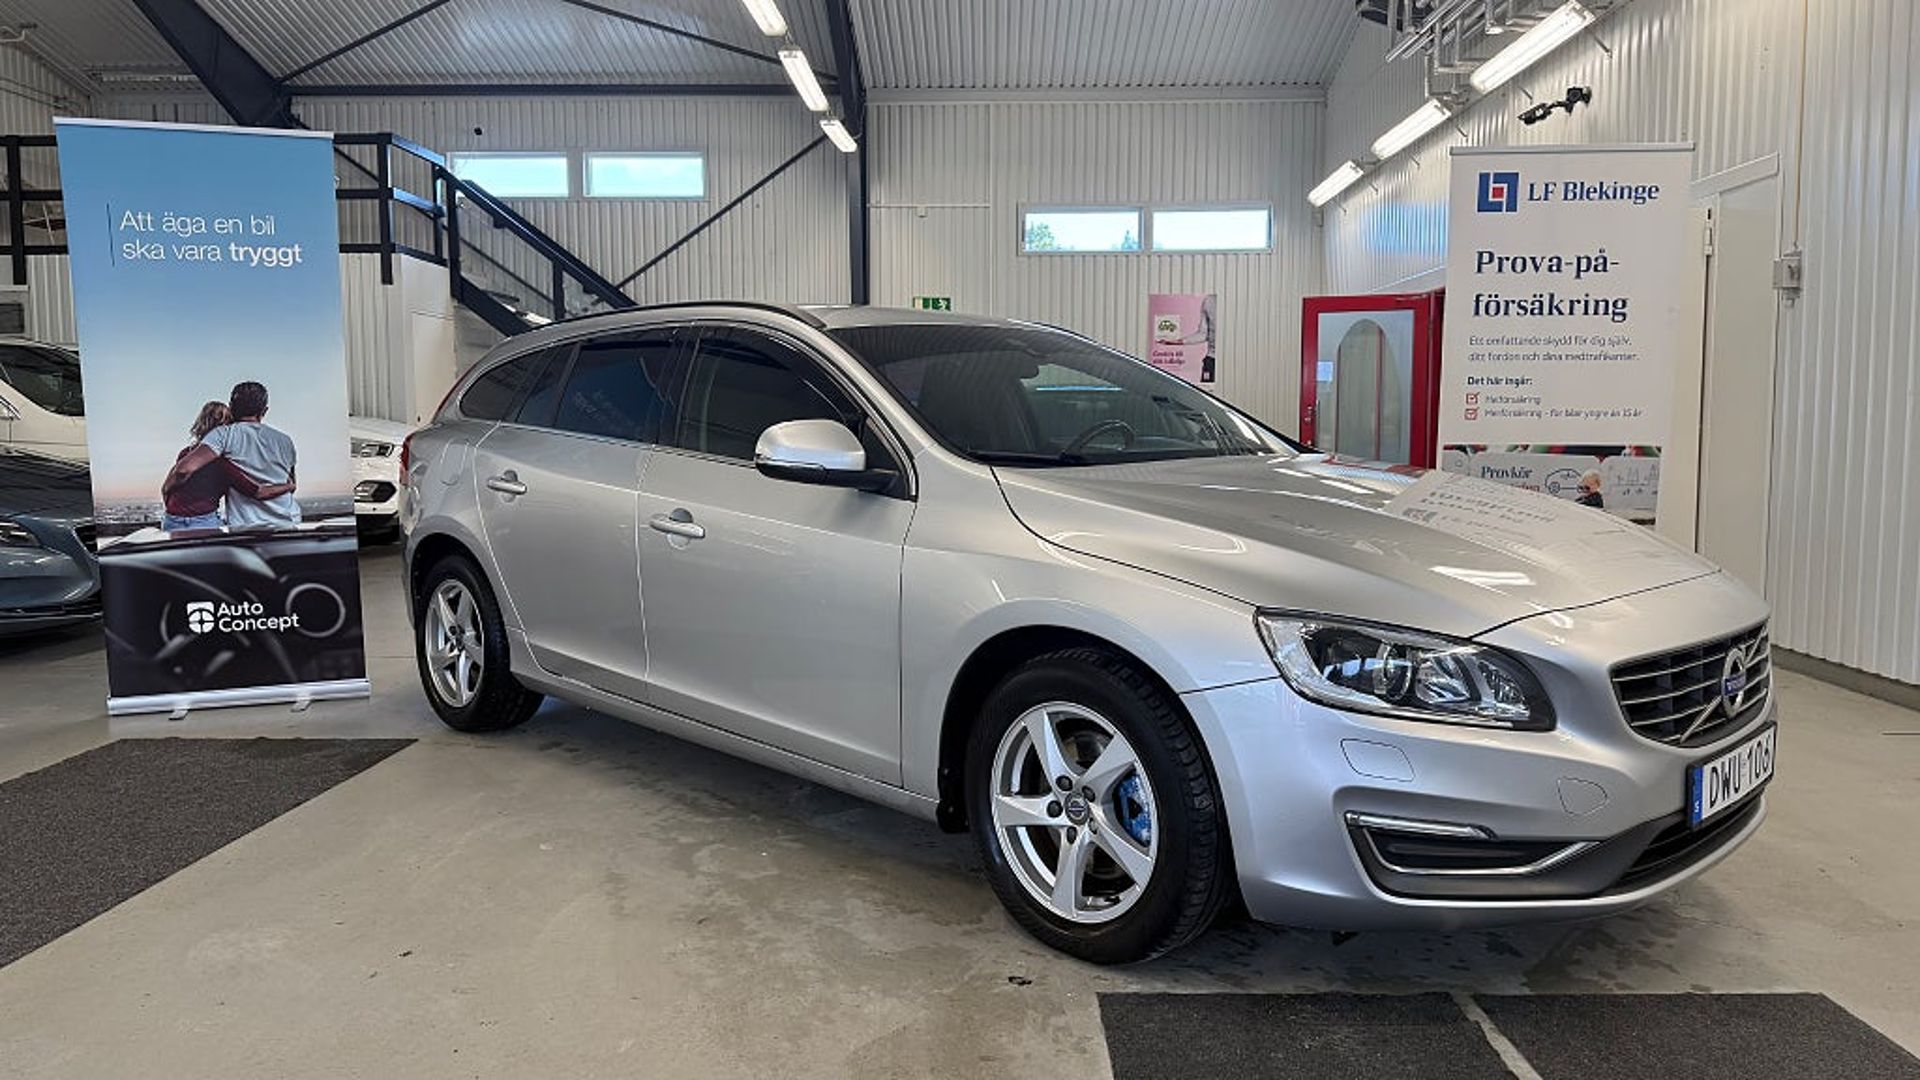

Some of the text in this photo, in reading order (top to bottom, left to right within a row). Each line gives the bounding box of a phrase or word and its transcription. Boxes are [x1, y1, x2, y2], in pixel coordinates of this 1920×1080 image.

[1528, 181, 1660, 205] LF Blekinge
[119, 210, 276, 237] Att äga en bil
[122, 240, 303, 268] ska vara tryggt
[1475, 248, 1620, 280] Prova-på-
[1472, 292, 1629, 323] försäkring
[1467, 375, 1533, 389] Det här ingår:
[217, 602, 263, 618] Auto
[218, 613, 300, 633] Concept
[1709, 753, 1741, 809] DWU
[1746, 733, 1771, 785] 106
